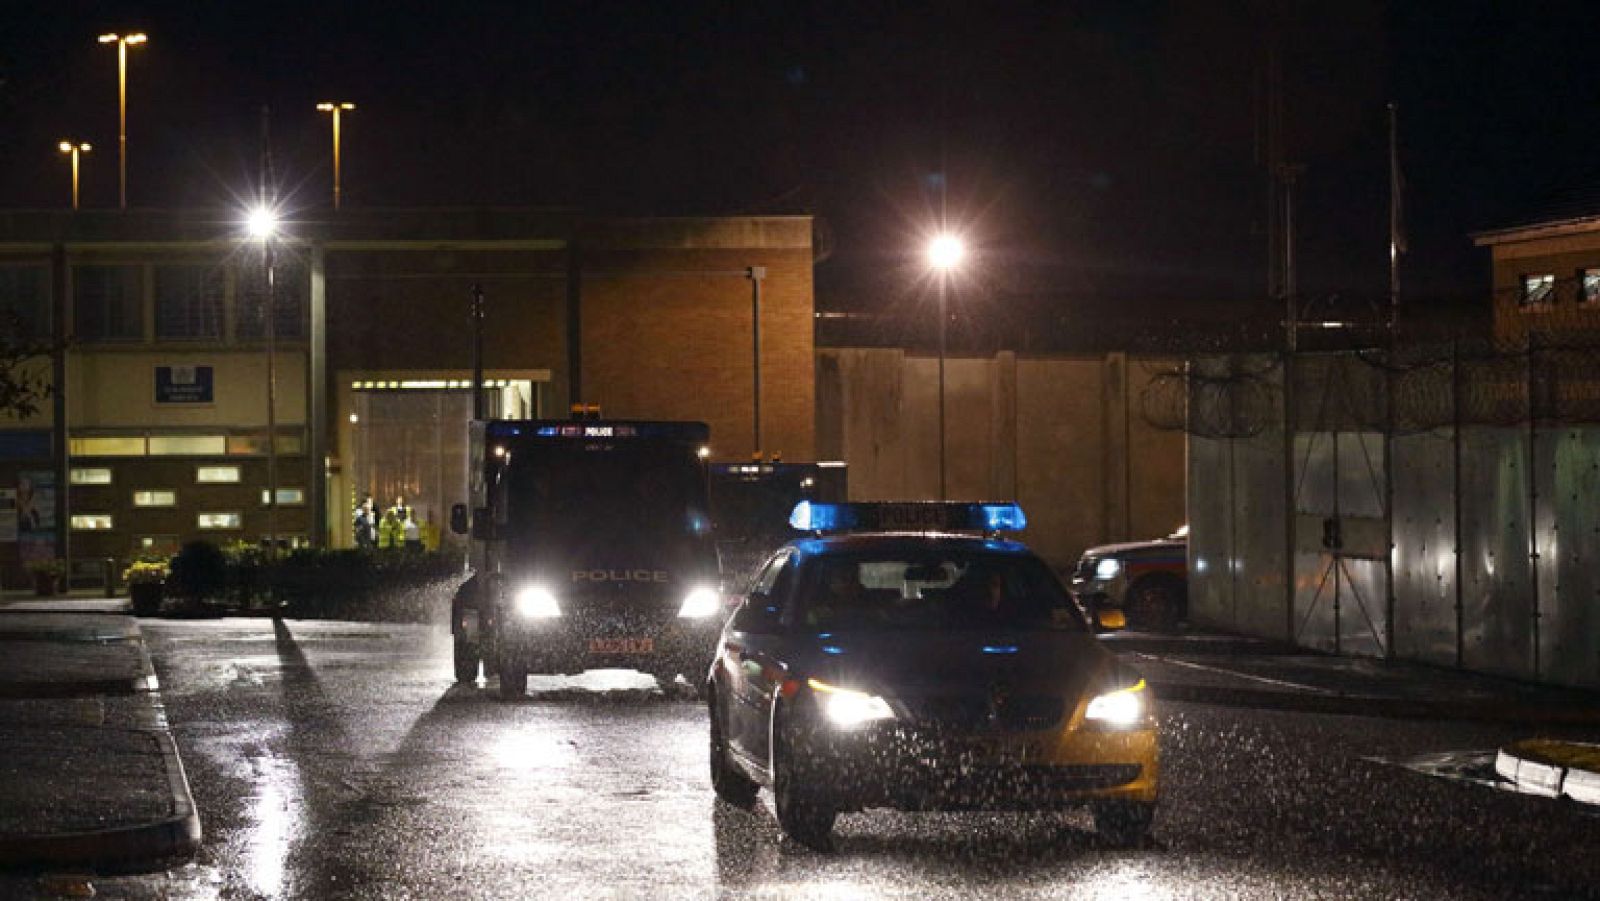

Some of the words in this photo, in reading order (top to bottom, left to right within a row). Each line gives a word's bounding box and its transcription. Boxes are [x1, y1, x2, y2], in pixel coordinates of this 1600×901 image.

[584, 427, 613, 437] POLICE
[880, 506, 946, 524] POLICE
[571, 569, 669, 583] POLICE
